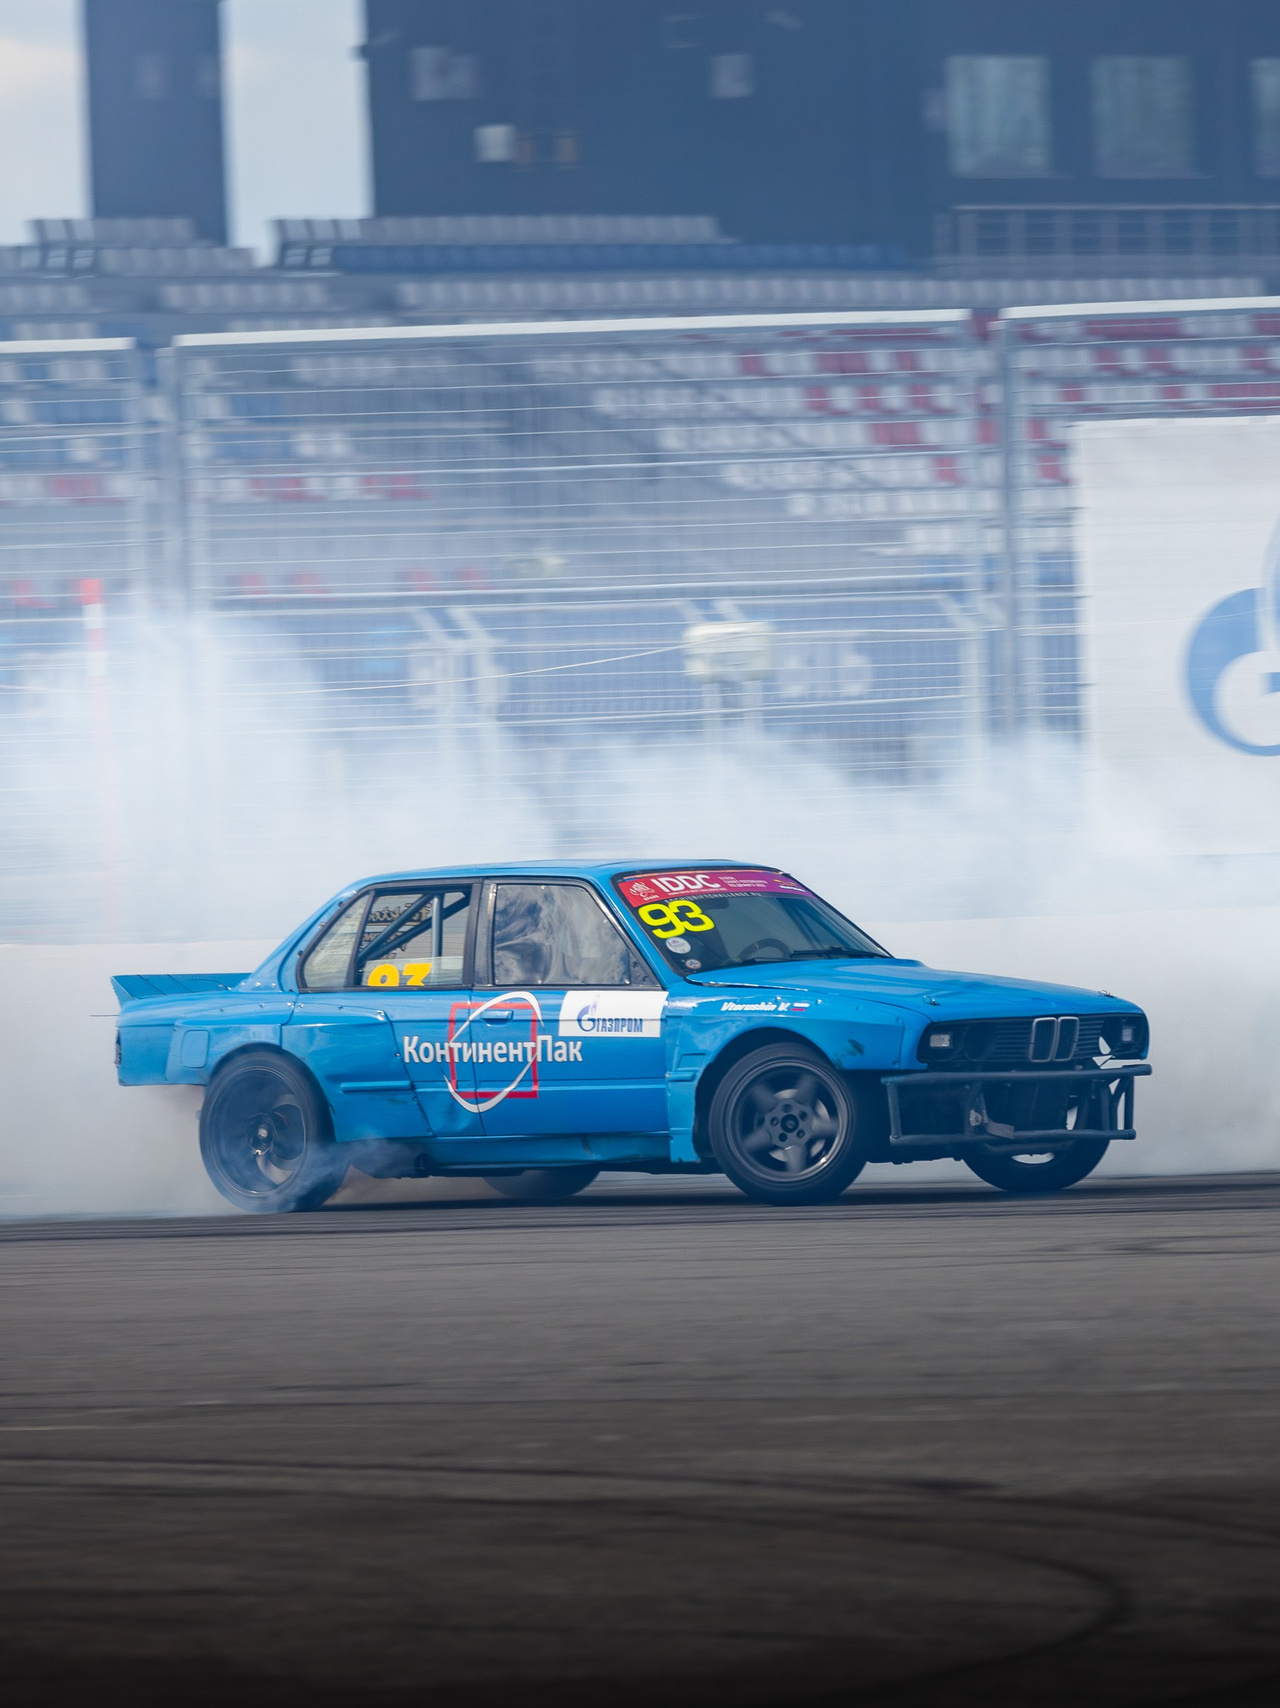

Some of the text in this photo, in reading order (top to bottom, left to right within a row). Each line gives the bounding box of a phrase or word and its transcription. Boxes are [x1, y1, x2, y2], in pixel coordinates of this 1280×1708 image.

[650, 874, 721, 893] IDDC
[637, 900, 715, 939] 93
[594, 1017, 644, 1034] ГАЗПРОМ
[403, 1034, 583, 1066] КонтинентПак
